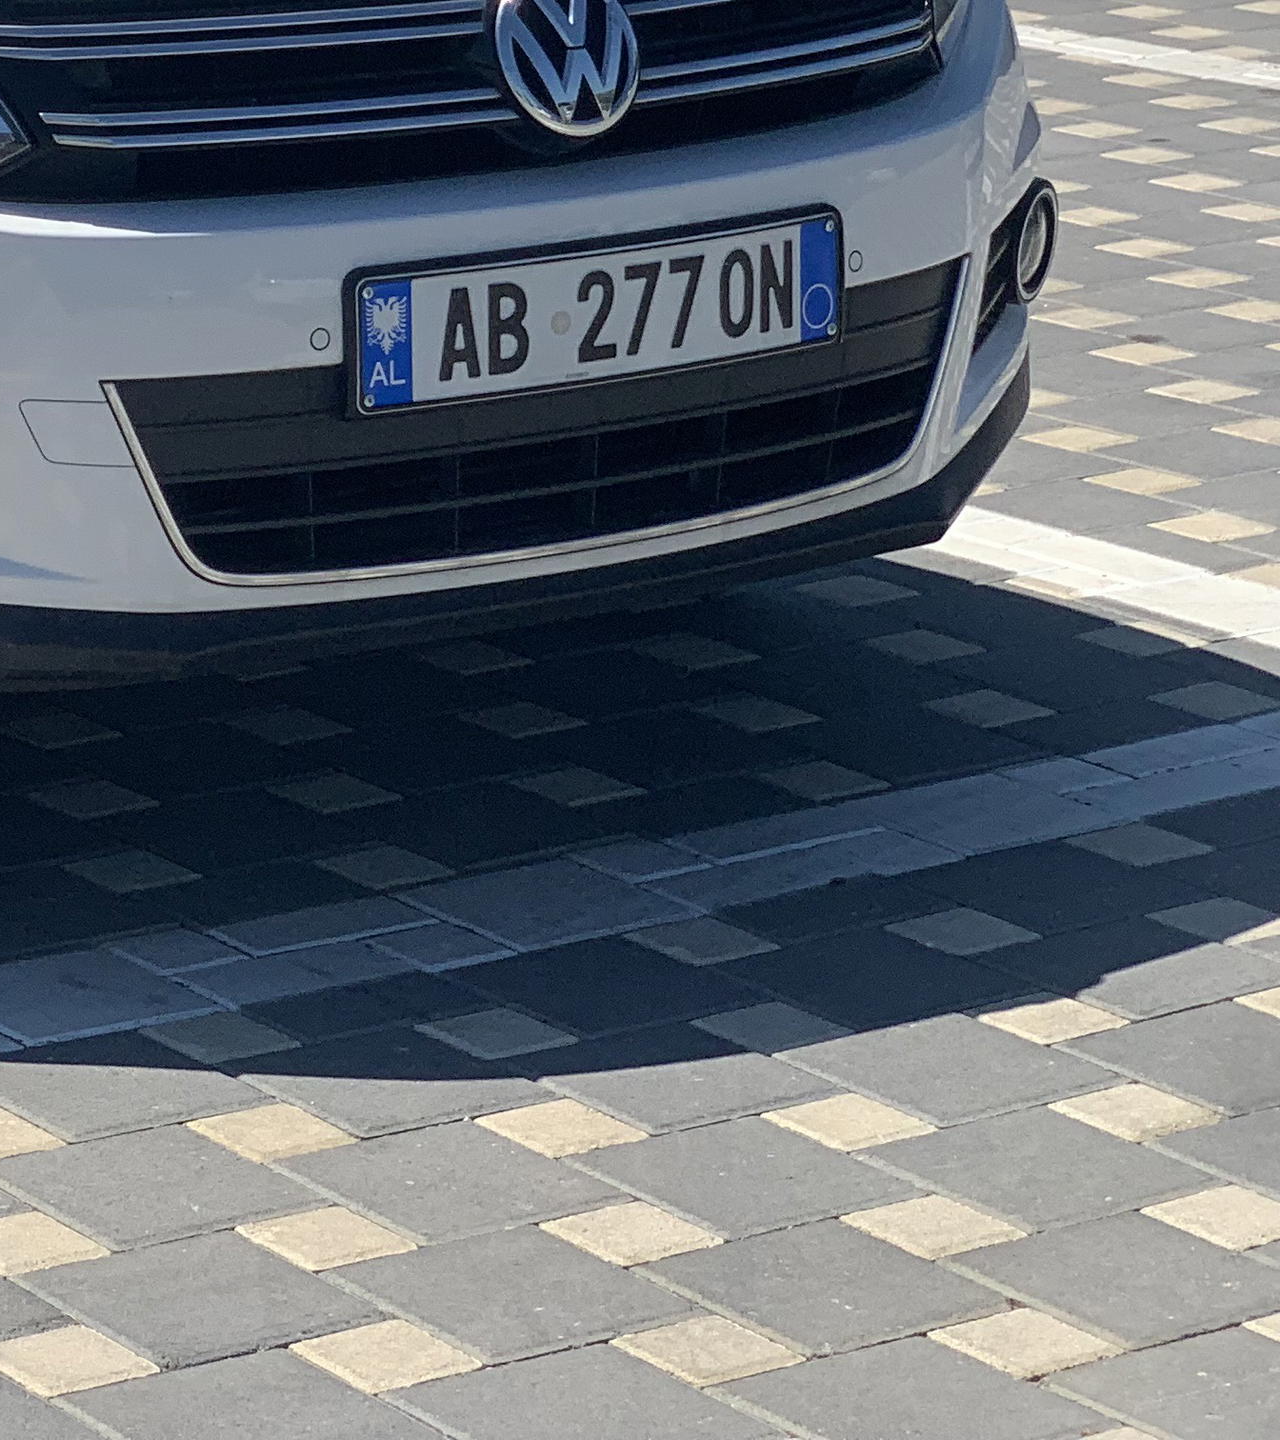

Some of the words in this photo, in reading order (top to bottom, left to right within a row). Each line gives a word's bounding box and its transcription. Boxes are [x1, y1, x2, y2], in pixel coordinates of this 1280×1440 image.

[439, 281, 531, 382] AB
[577, 254, 705, 363] 277
[719, 239, 794, 339] ON
[369, 361, 407, 389] AL
